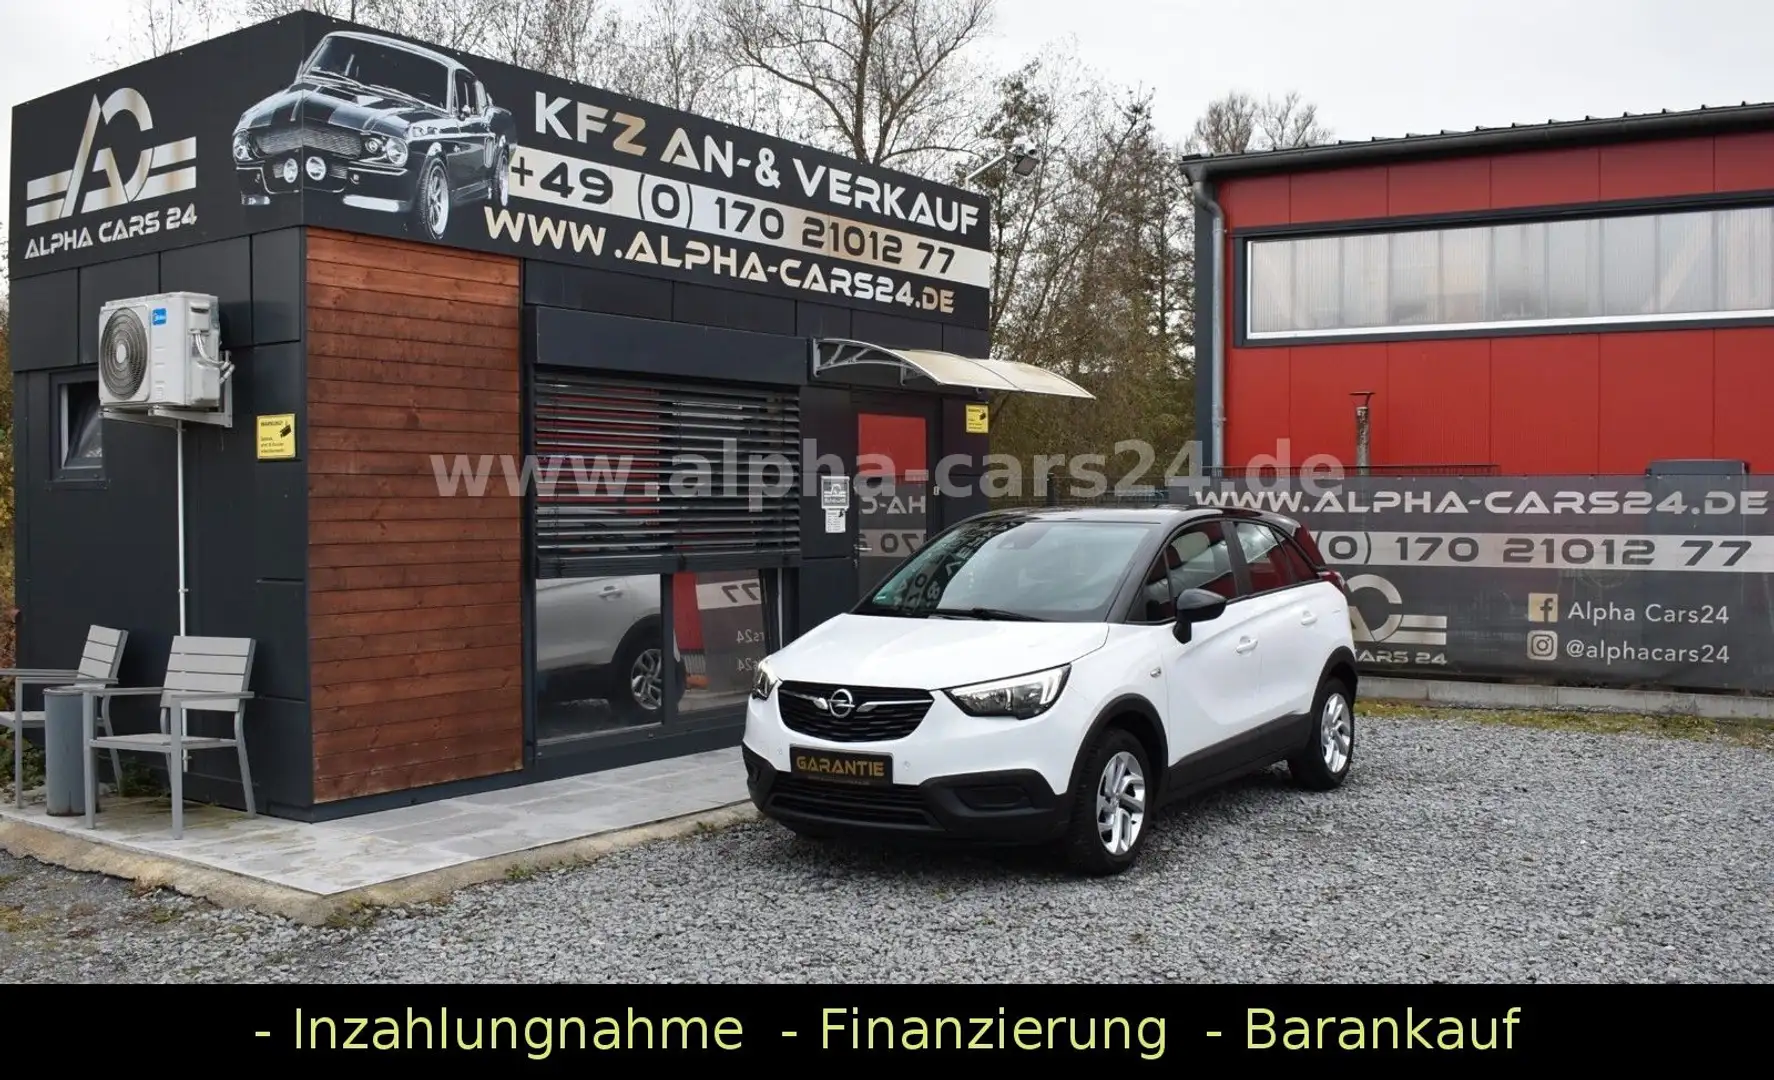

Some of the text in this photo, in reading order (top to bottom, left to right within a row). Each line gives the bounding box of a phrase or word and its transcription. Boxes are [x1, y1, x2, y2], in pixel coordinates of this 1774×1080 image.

[535, 91, 647, 156] KFZ
[792, 157, 980, 234] VERKAUF
[511, 156, 955, 274] +49 (0) 170 21012 77
[24, 202, 198, 259] ALPHA CARS 24
[1194, 490, 1769, 515] WWW.ALPHA-CARS24.DE
[1395, 536, 1480, 562] 170
[1503, 537, 1656, 565] 21012
[1680, 540, 1753, 566] 77
[1567, 601, 1635, 626] Alpha
[1645, 604, 1730, 624] Cars24
[1354, 649, 1448, 666] ARS 24
[1566, 640, 1730, 665] @alphacars24
[796, 755, 885, 777] GARANTIE
